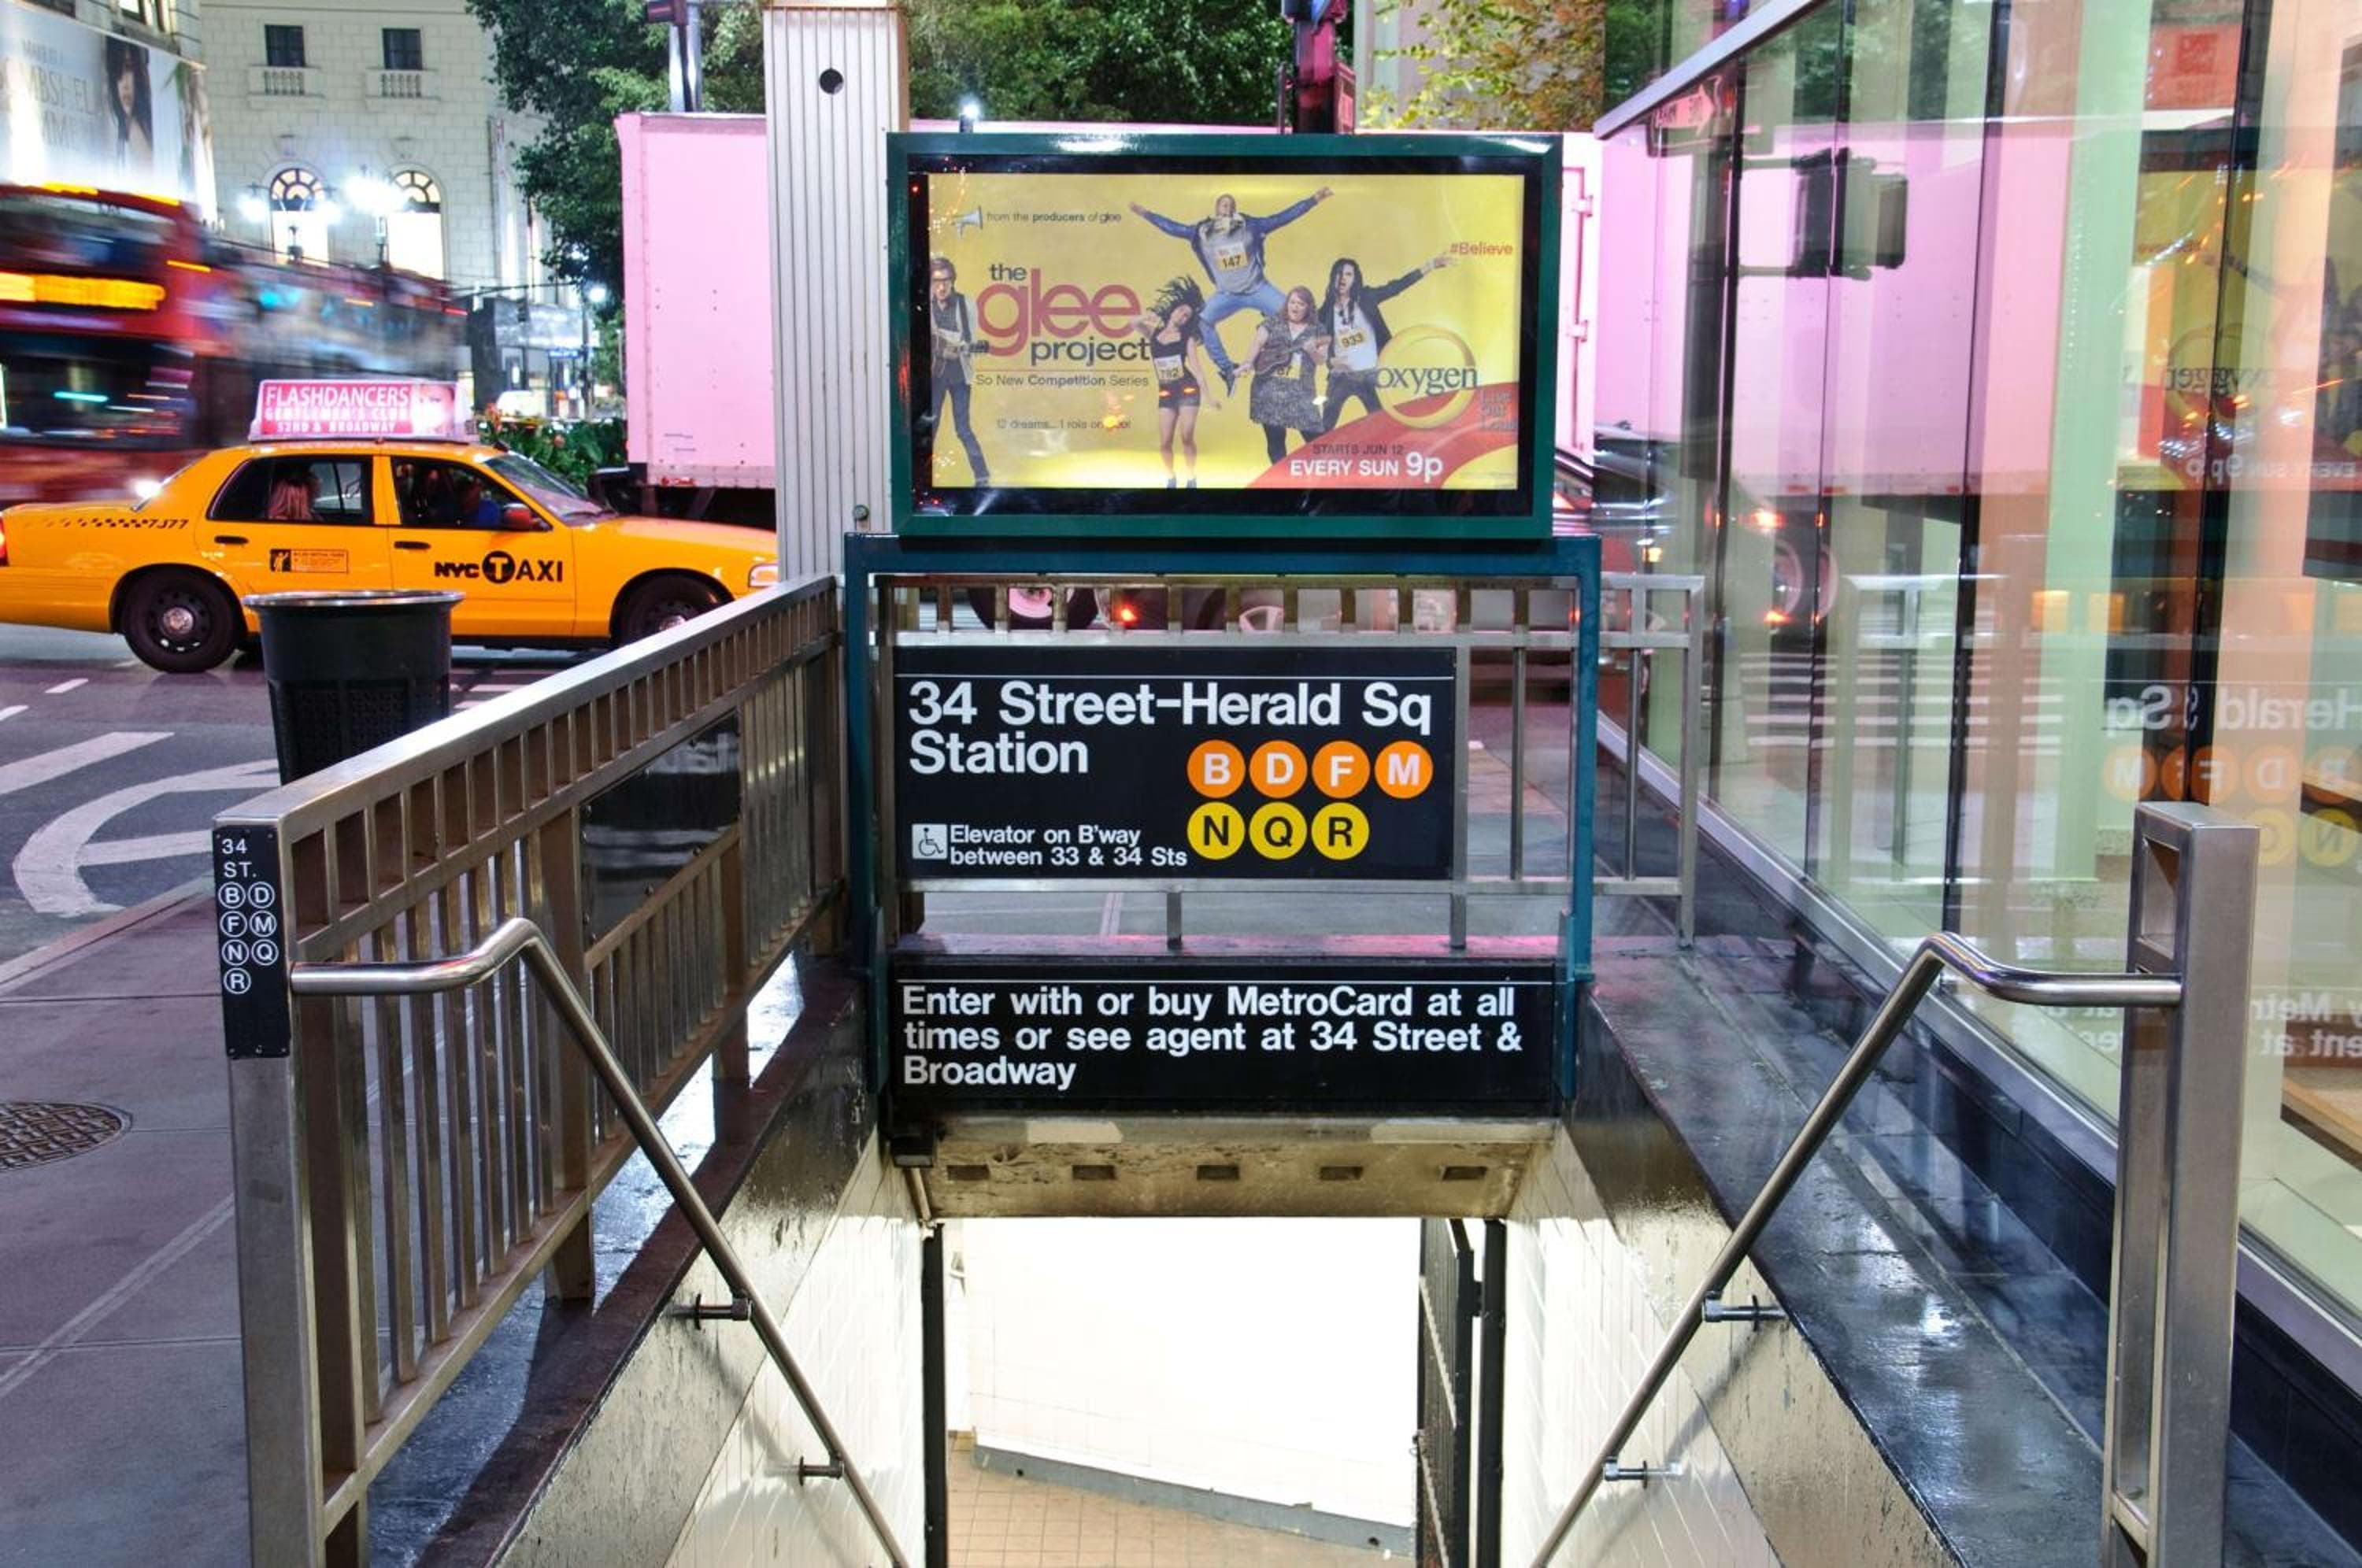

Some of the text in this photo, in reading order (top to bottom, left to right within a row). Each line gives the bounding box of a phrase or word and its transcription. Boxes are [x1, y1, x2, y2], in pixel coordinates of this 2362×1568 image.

[987, 212, 1009, 221] from
[1013, 212, 1029, 221] the
[1032, 212, 1085, 224] producers
[1088, 212, 1098, 221] of
[1449, 241, 1513, 256] #Believe
[1222, 254, 1242, 268] 147
[990, 264, 1027, 281] the
[976, 268, 1141, 357] glee
[1341, 331, 1363, 348] 933
[1031, 336, 1150, 366] project
[976, 374, 1149, 388] So New Competition Series
[1375, 365, 1478, 395] oxygen
[266, 386, 409, 407] FLASHDANCERS
[277, 421, 309, 432] 52ND
[328, 421, 394, 432] BROADWAY
[1313, 444, 1404, 454] STARTS JUN 12
[1290, 452, 1443, 483] EVERY SUN 9p
[434, 550, 563, 584] NYC TAXI
[909, 680, 1431, 736] 34 Street-Herald Sq
[909, 729, 1090, 775] Station
[1204, 753, 1420, 787] B D F M
[950, 824, 1141, 848] Elevator on B'way
[1203, 815, 1353, 848] N Q R
[222, 838, 248, 855] 34
[950, 847, 1188, 867] between 33 & 34 Sts
[224, 862, 257, 878] ST.
[224, 887, 270, 904] B D
[227, 916, 272, 933] F M
[228, 945, 273, 961] N Q
[230, 973, 246, 989] R
[903, 986, 1515, 1022] Enter with or buy MetroCard at all
[904, 1021, 1523, 1057] times or see agent at 34 Street &
[903, 1055, 1076, 1091] Broadway
